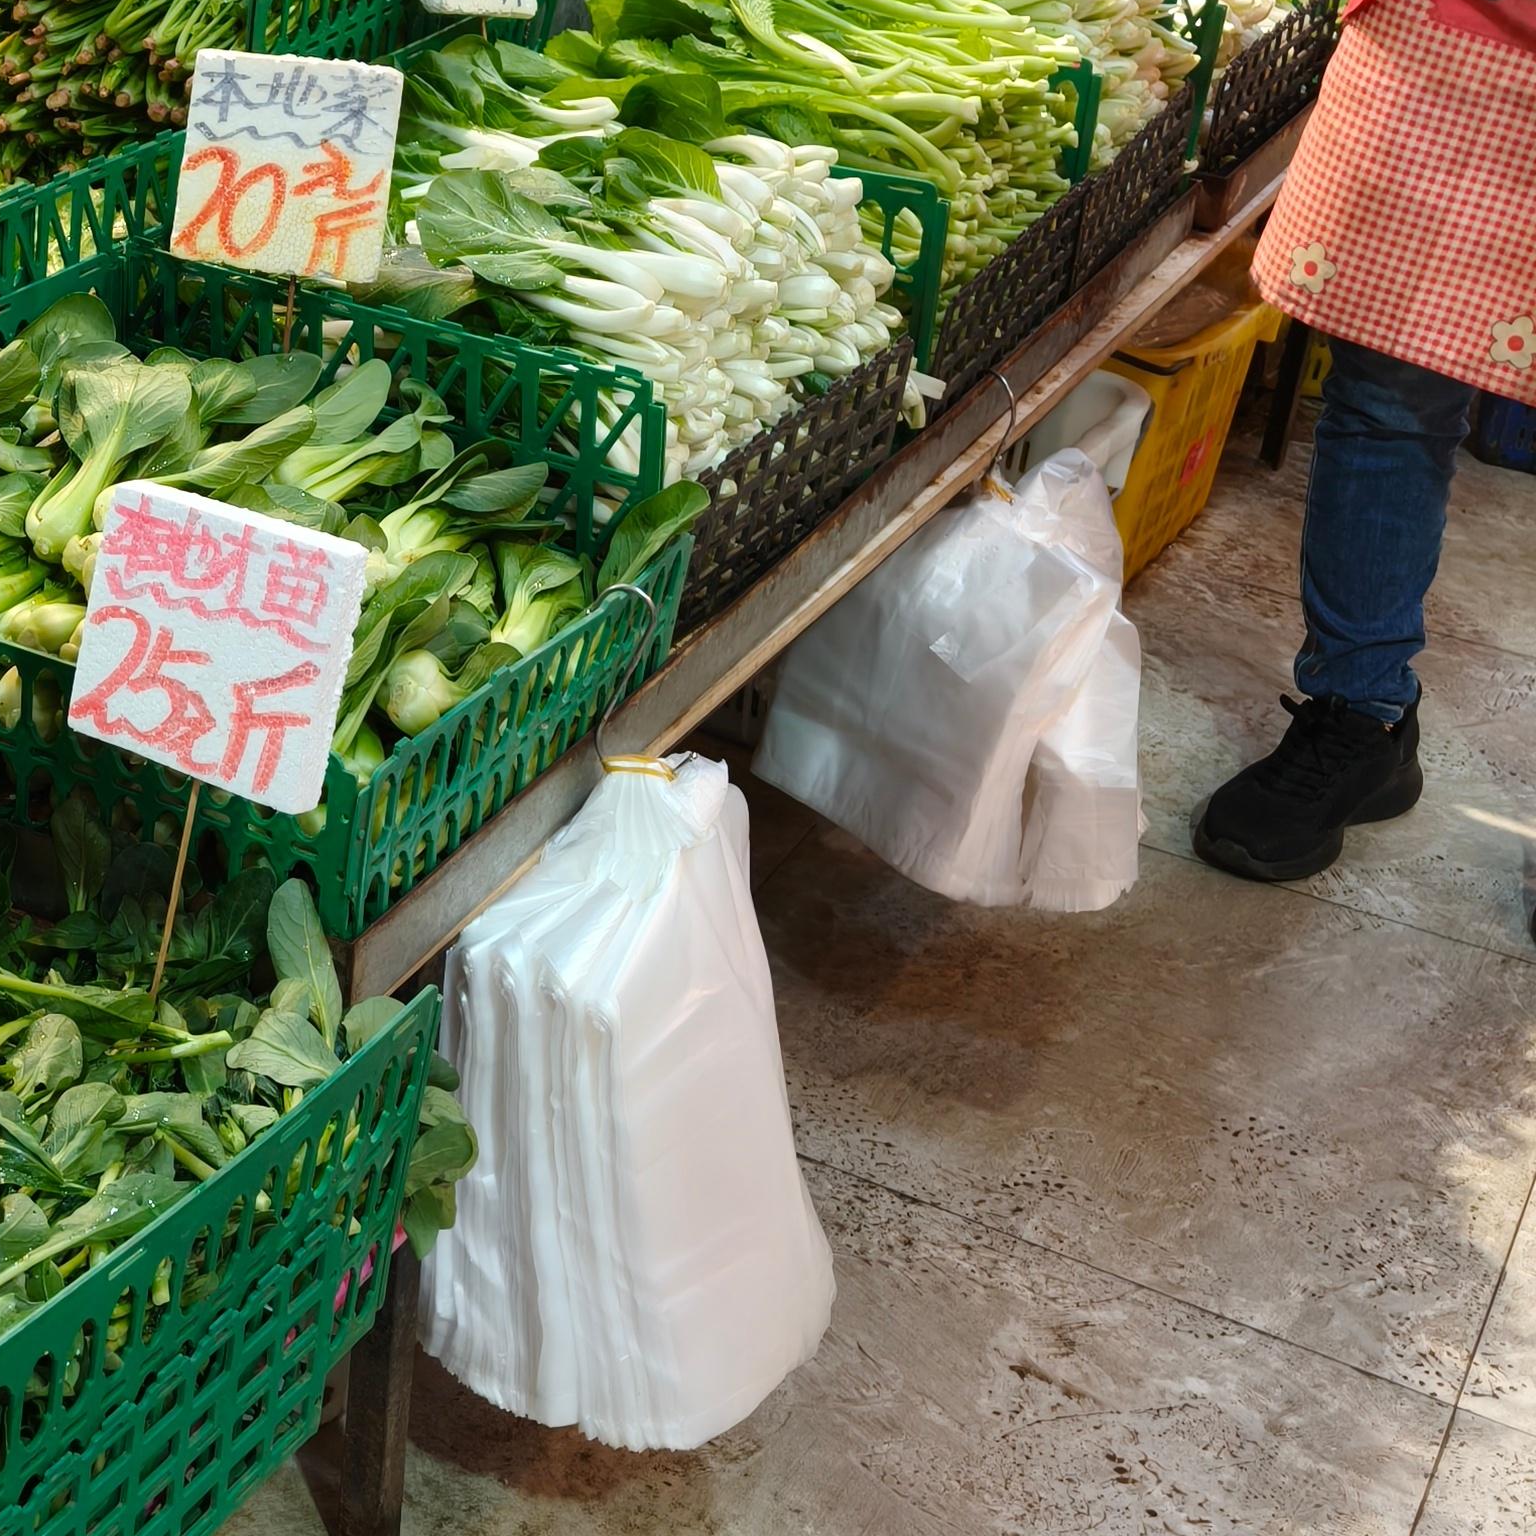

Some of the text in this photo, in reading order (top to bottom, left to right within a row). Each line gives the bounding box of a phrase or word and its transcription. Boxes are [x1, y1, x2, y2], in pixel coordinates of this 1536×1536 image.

[192, 58, 395, 138] 本地菜
[172, 139, 386, 278] 20元斤
[68, 605, 321, 794] 25元斤
